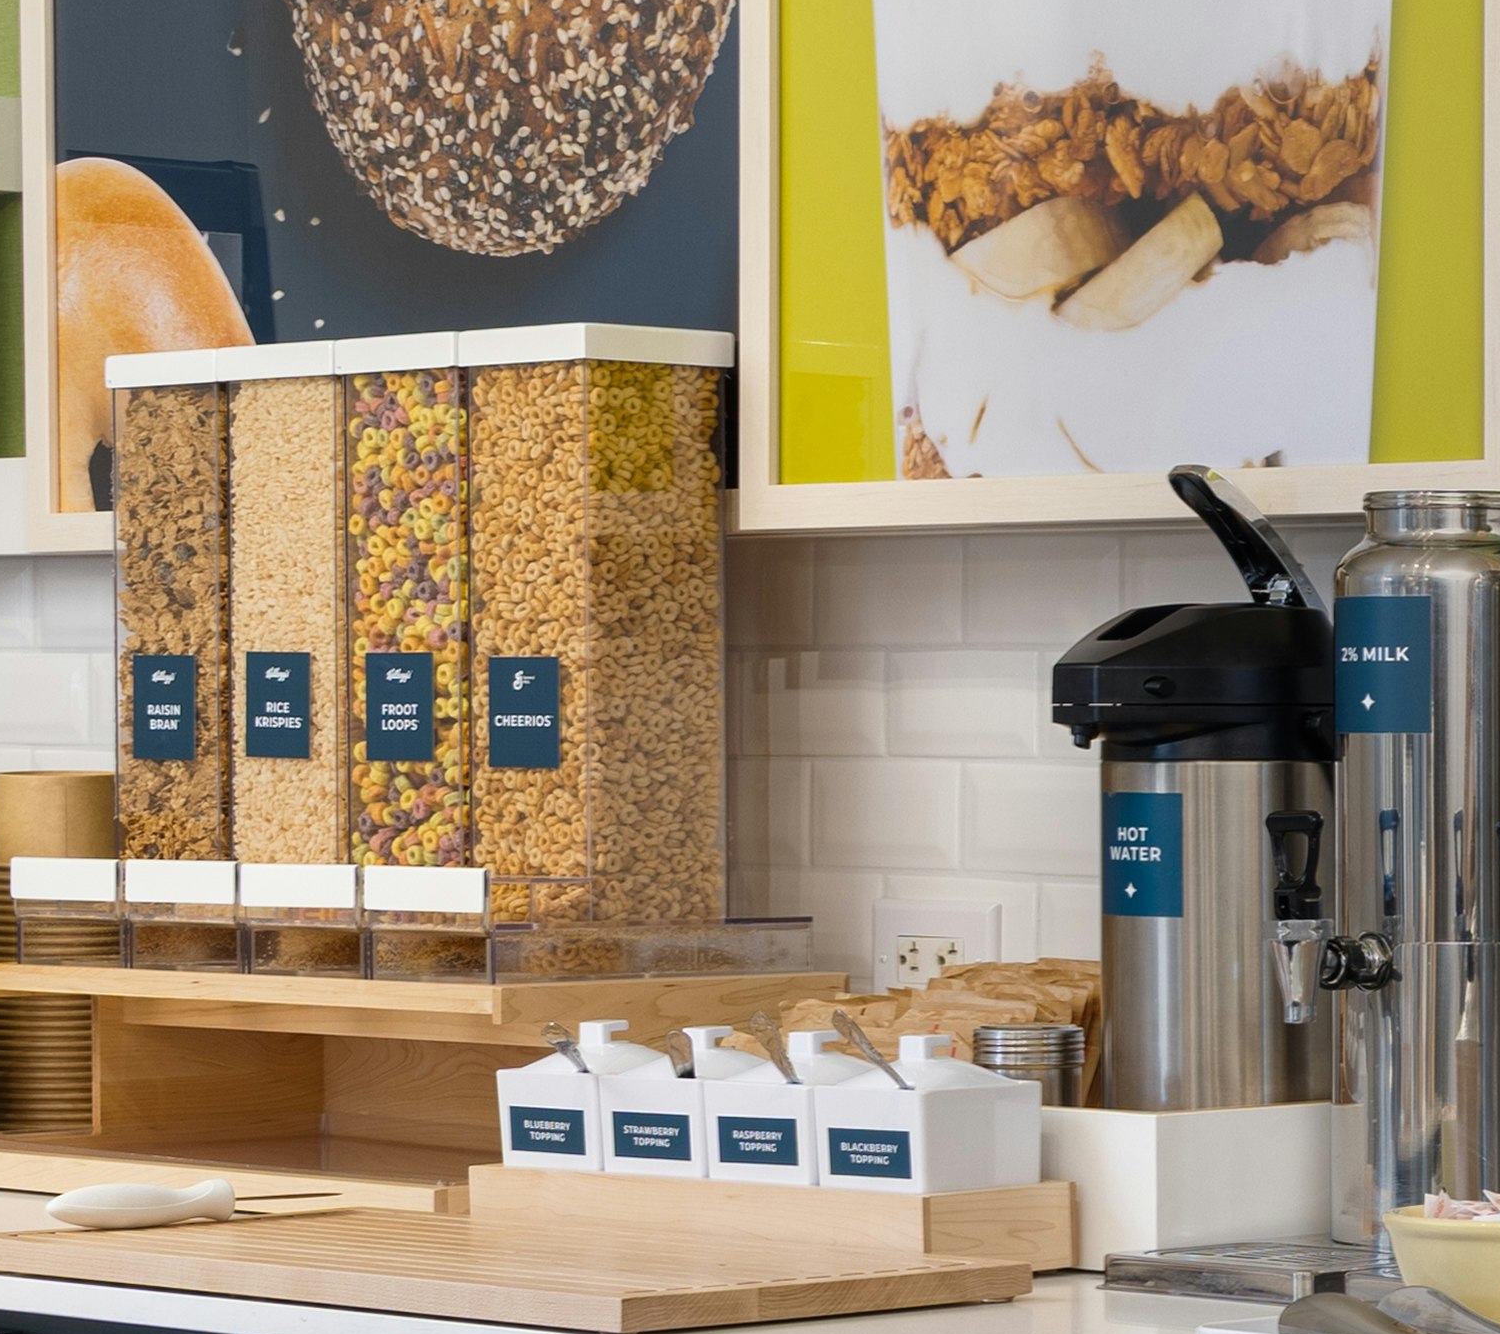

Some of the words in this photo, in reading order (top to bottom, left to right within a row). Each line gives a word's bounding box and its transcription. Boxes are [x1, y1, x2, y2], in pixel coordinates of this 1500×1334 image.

[1341, 646, 1359, 662] 2%
[1362, 646, 1410, 662] MILK
[146, 704, 182, 717] RAISIN
[265, 701, 291, 715] RICE
[381, 703, 419, 716] FROOT
[149, 718, 179, 731] BRAN
[254, 716, 302, 730] KRISPIES
[381, 718, 418, 732] LOOPS
[494, 714, 552, 728] CHEERIOS
[1117, 826, 1149, 842] HOT
[1109, 845, 1162, 862] WATER
[523, 1119, 572, 1132] BLUEBERRY
[622, 1124, 681, 1137] STRAWBERRY
[529, 1130, 566, 1143] TOPPING
[632, 1136, 671, 1148] TOPPING
[732, 1129, 784, 1142] RASPBERRY
[738, 1140, 778, 1153] TOPPING
[840, 1141, 899, 1154] BLACKBERRY
[850, 1153, 890, 1166] TOPPING
